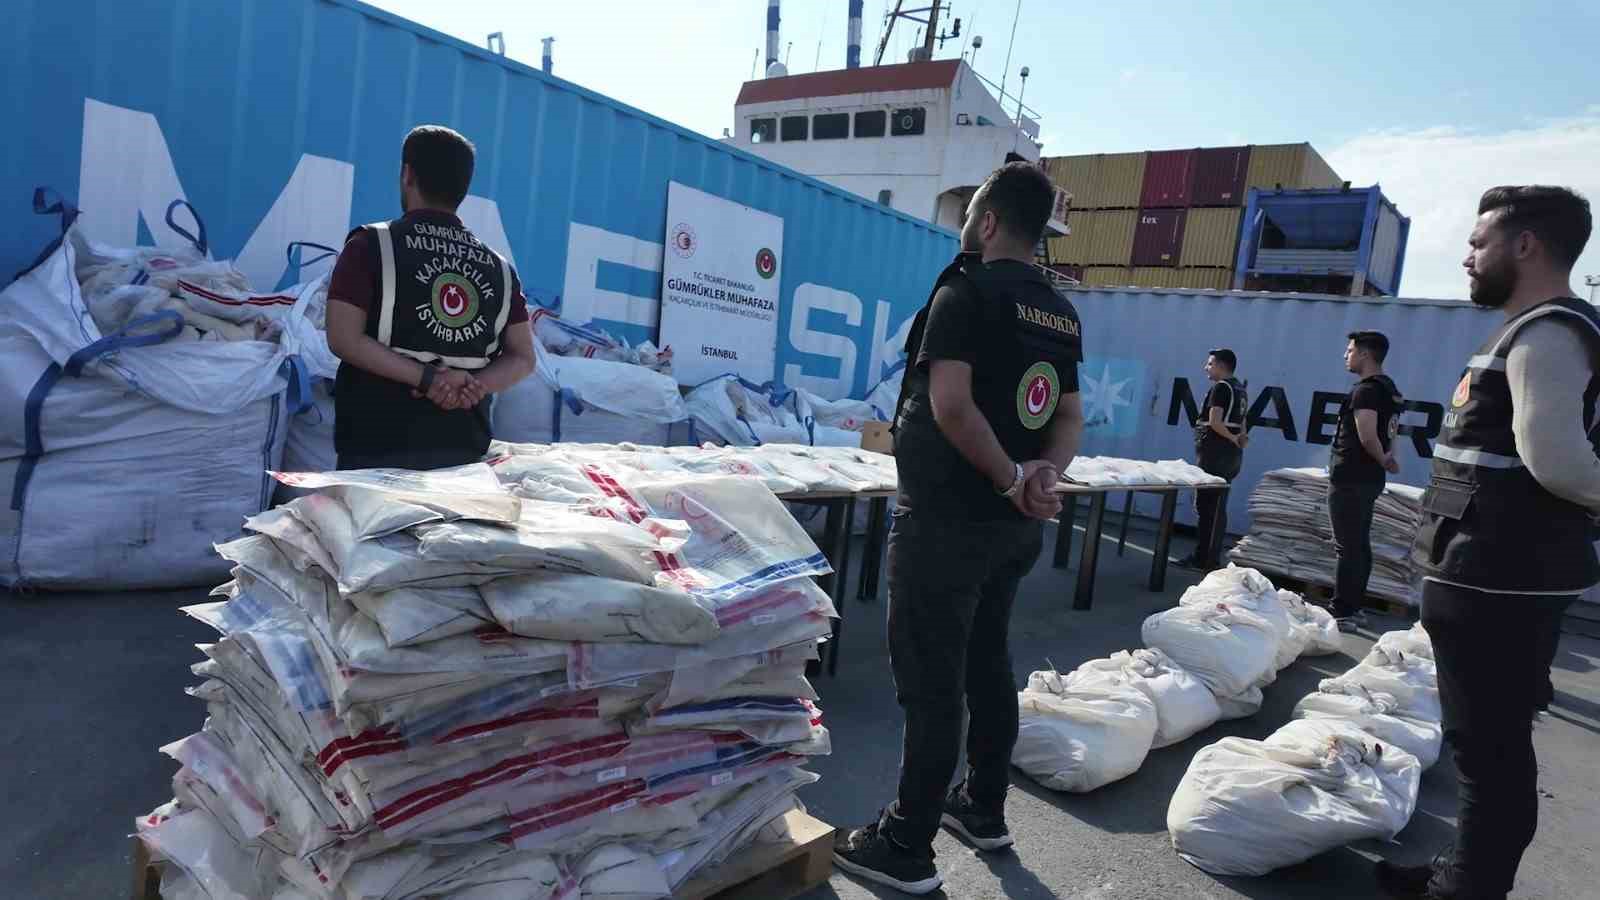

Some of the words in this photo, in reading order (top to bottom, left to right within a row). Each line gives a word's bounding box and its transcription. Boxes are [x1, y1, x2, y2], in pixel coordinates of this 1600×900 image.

[405, 234, 496, 268] MUHAFAZA
[415, 257, 495, 300] KAÇAKÇILIK
[668, 279, 725, 300] GÜMRÜKLER
[727, 292, 775, 311] MUHAFAZA
[415, 302, 489, 343] İSTİHBARAT
[1016, 302, 1079, 336] NARKOKİM
[701, 344, 738, 361] İSTANBUL
[1166, 377, 1445, 459] MAER
